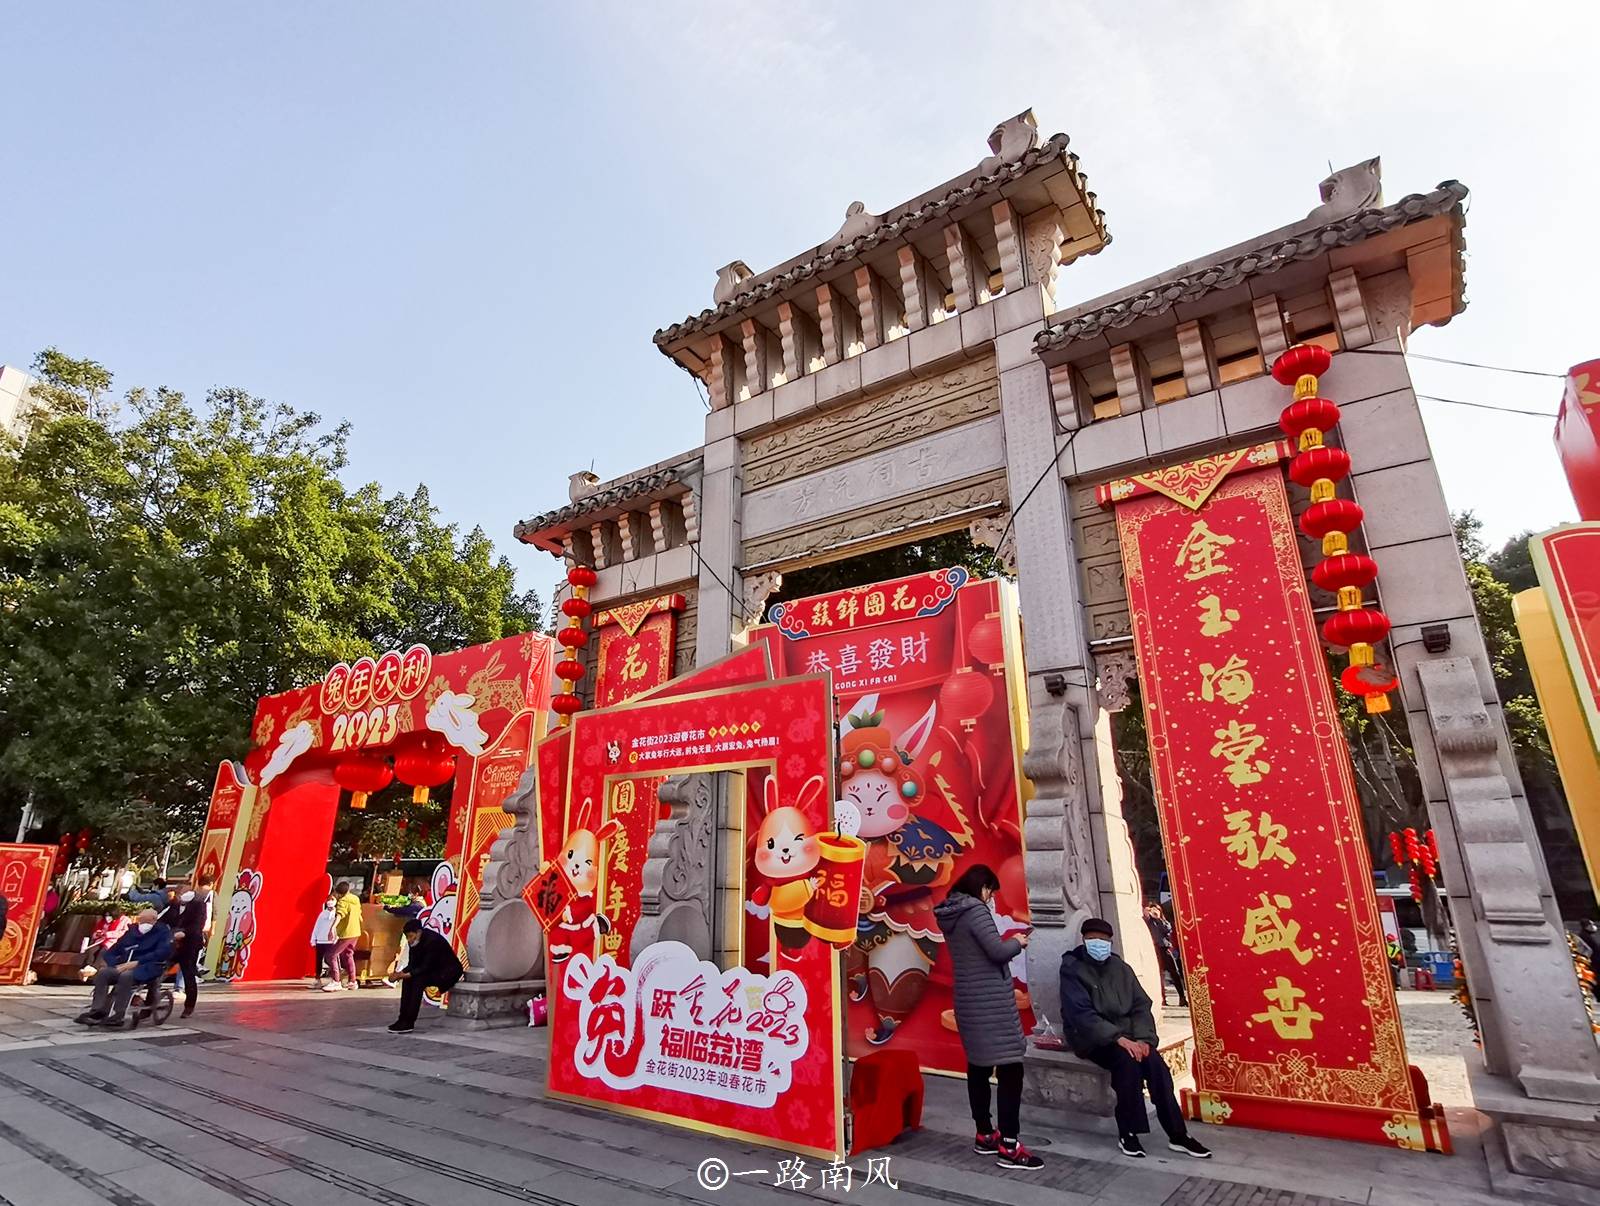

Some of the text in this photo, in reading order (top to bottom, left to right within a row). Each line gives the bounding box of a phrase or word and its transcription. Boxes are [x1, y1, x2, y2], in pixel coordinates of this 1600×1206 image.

[804, 631, 931, 677] 恭喜發財
[326, 653, 427, 704] 兔年大利
[859, 679, 868, 687] XI
[883, 675, 897, 683] CAI
[330, 703, 400, 752] 2023
[631, 729, 706, 748] 金花街2023迎春花市
[481, 764, 520, 784] Chinese
[5, 866, 22, 892] 入口
[659, 1023, 764, 1073] 福临荔湾
[645, 1058, 768, 1095] 金花街2023年迎春花市
